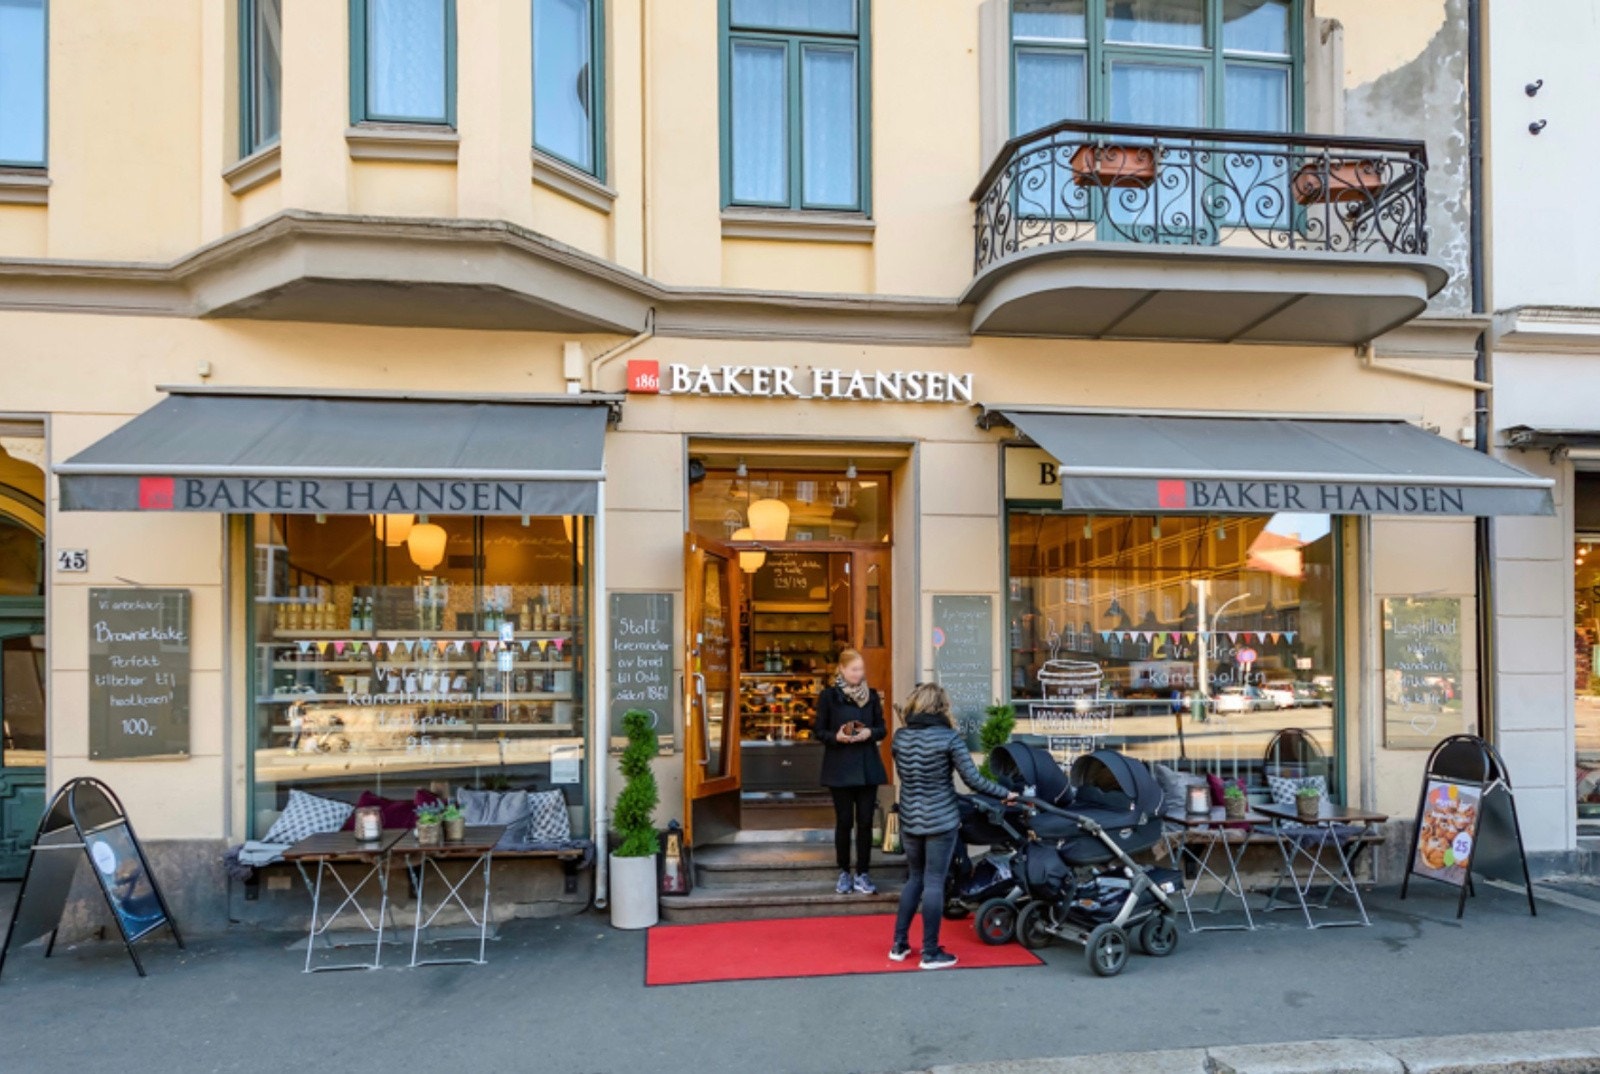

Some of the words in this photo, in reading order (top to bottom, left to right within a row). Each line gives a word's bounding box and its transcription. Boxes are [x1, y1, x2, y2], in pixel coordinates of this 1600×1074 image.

[634, 372, 659, 388] 1861
[670, 362, 802, 399] BAKER
[811, 367, 975, 403] HANSEN
[1038, 461, 1062, 486] B
[184, 478, 329, 509] BAKER
[345, 480, 525, 511] HANSEN
[1191, 481, 1306, 509] BAKER
[1320, 484, 1465, 512] HANSEN
[58, 551, 85, 569] 45
[620, 617, 661, 636] Stolt
[617, 659, 635, 669] av
[155, 672, 176, 688] til
[617, 672, 632, 683] til
[1454, 839, 1469, 853] 25
